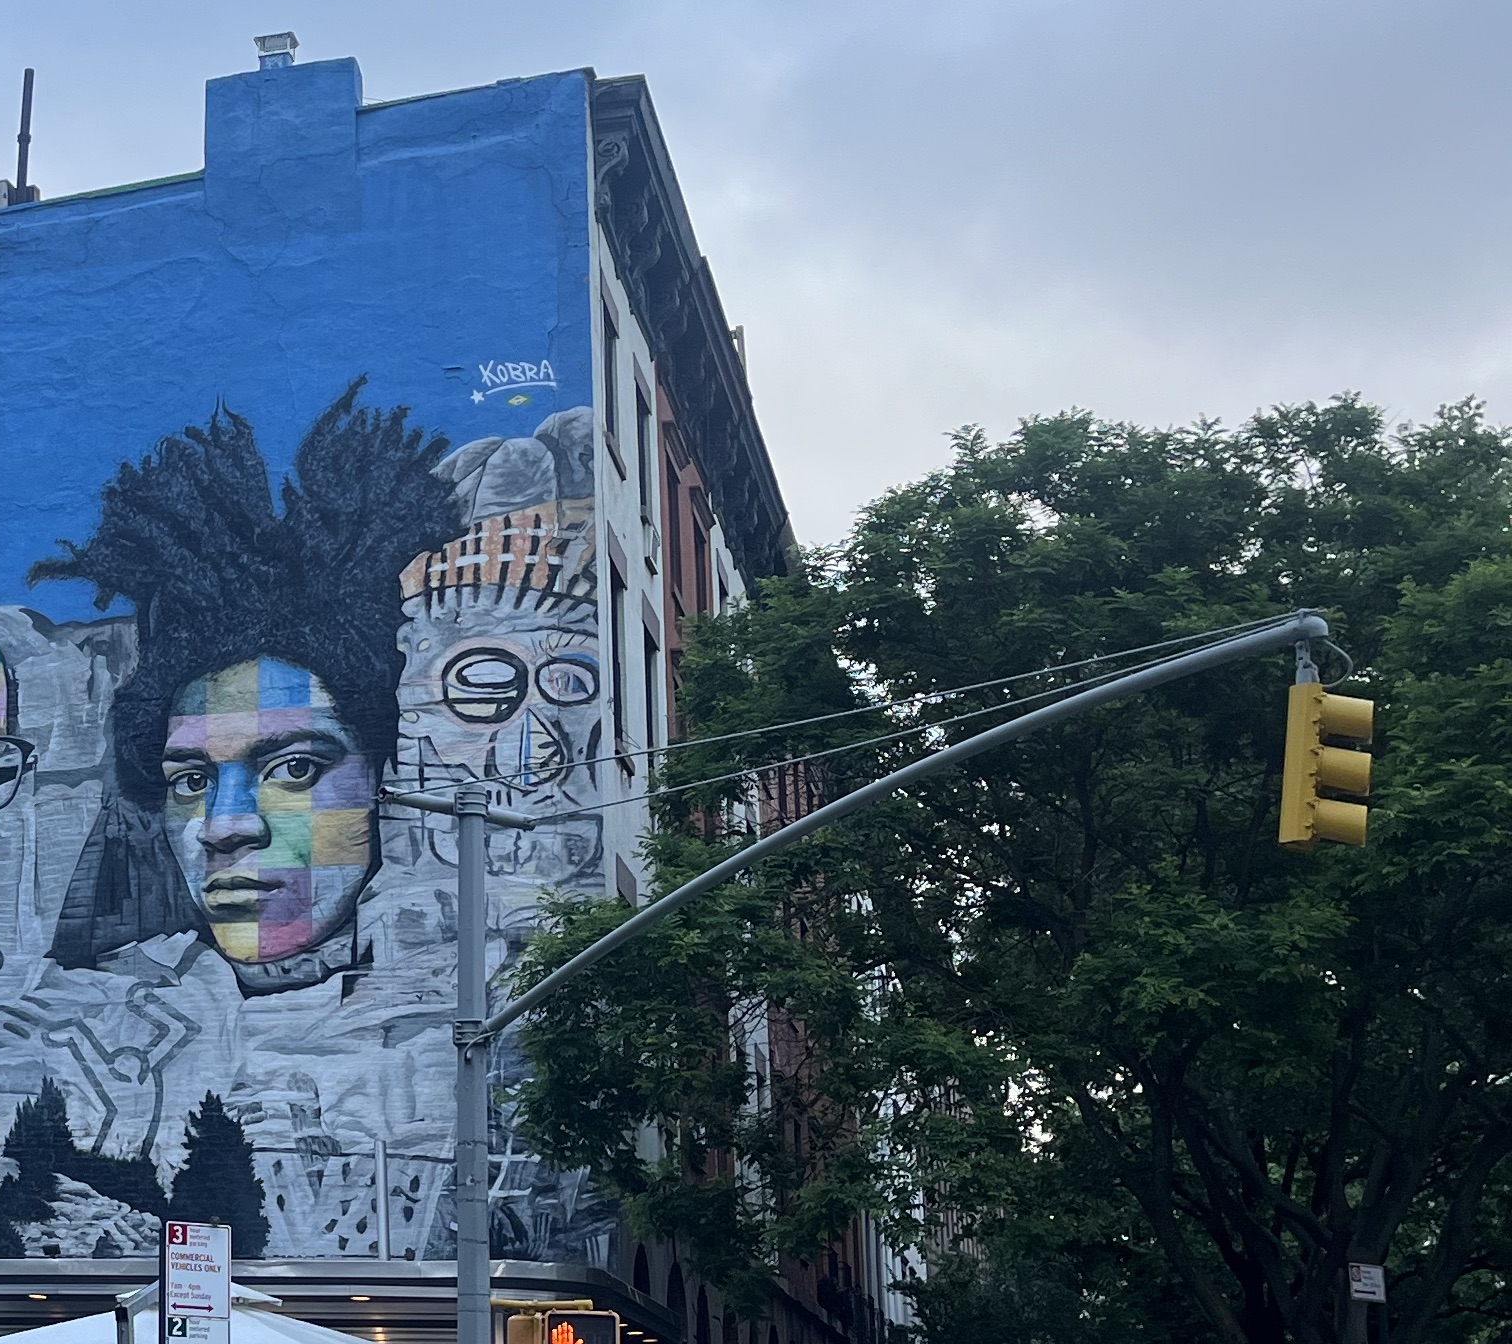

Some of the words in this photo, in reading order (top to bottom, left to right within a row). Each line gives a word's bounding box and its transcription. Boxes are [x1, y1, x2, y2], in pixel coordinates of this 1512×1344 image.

[479, 360, 555, 387] KOBRA
[172, 1225, 183, 1243] 3
[170, 1252, 214, 1263] COMMERCIAL
[170, 1262, 202, 1272] VEHICLES
[204, 1264, 222, 1273] ONLY
[188, 1283, 201, 1291] 4pm
[170, 1290, 190, 1299] Except
[191, 1292, 212, 1301] Sunday
[172, 1317, 183, 1336] 2
